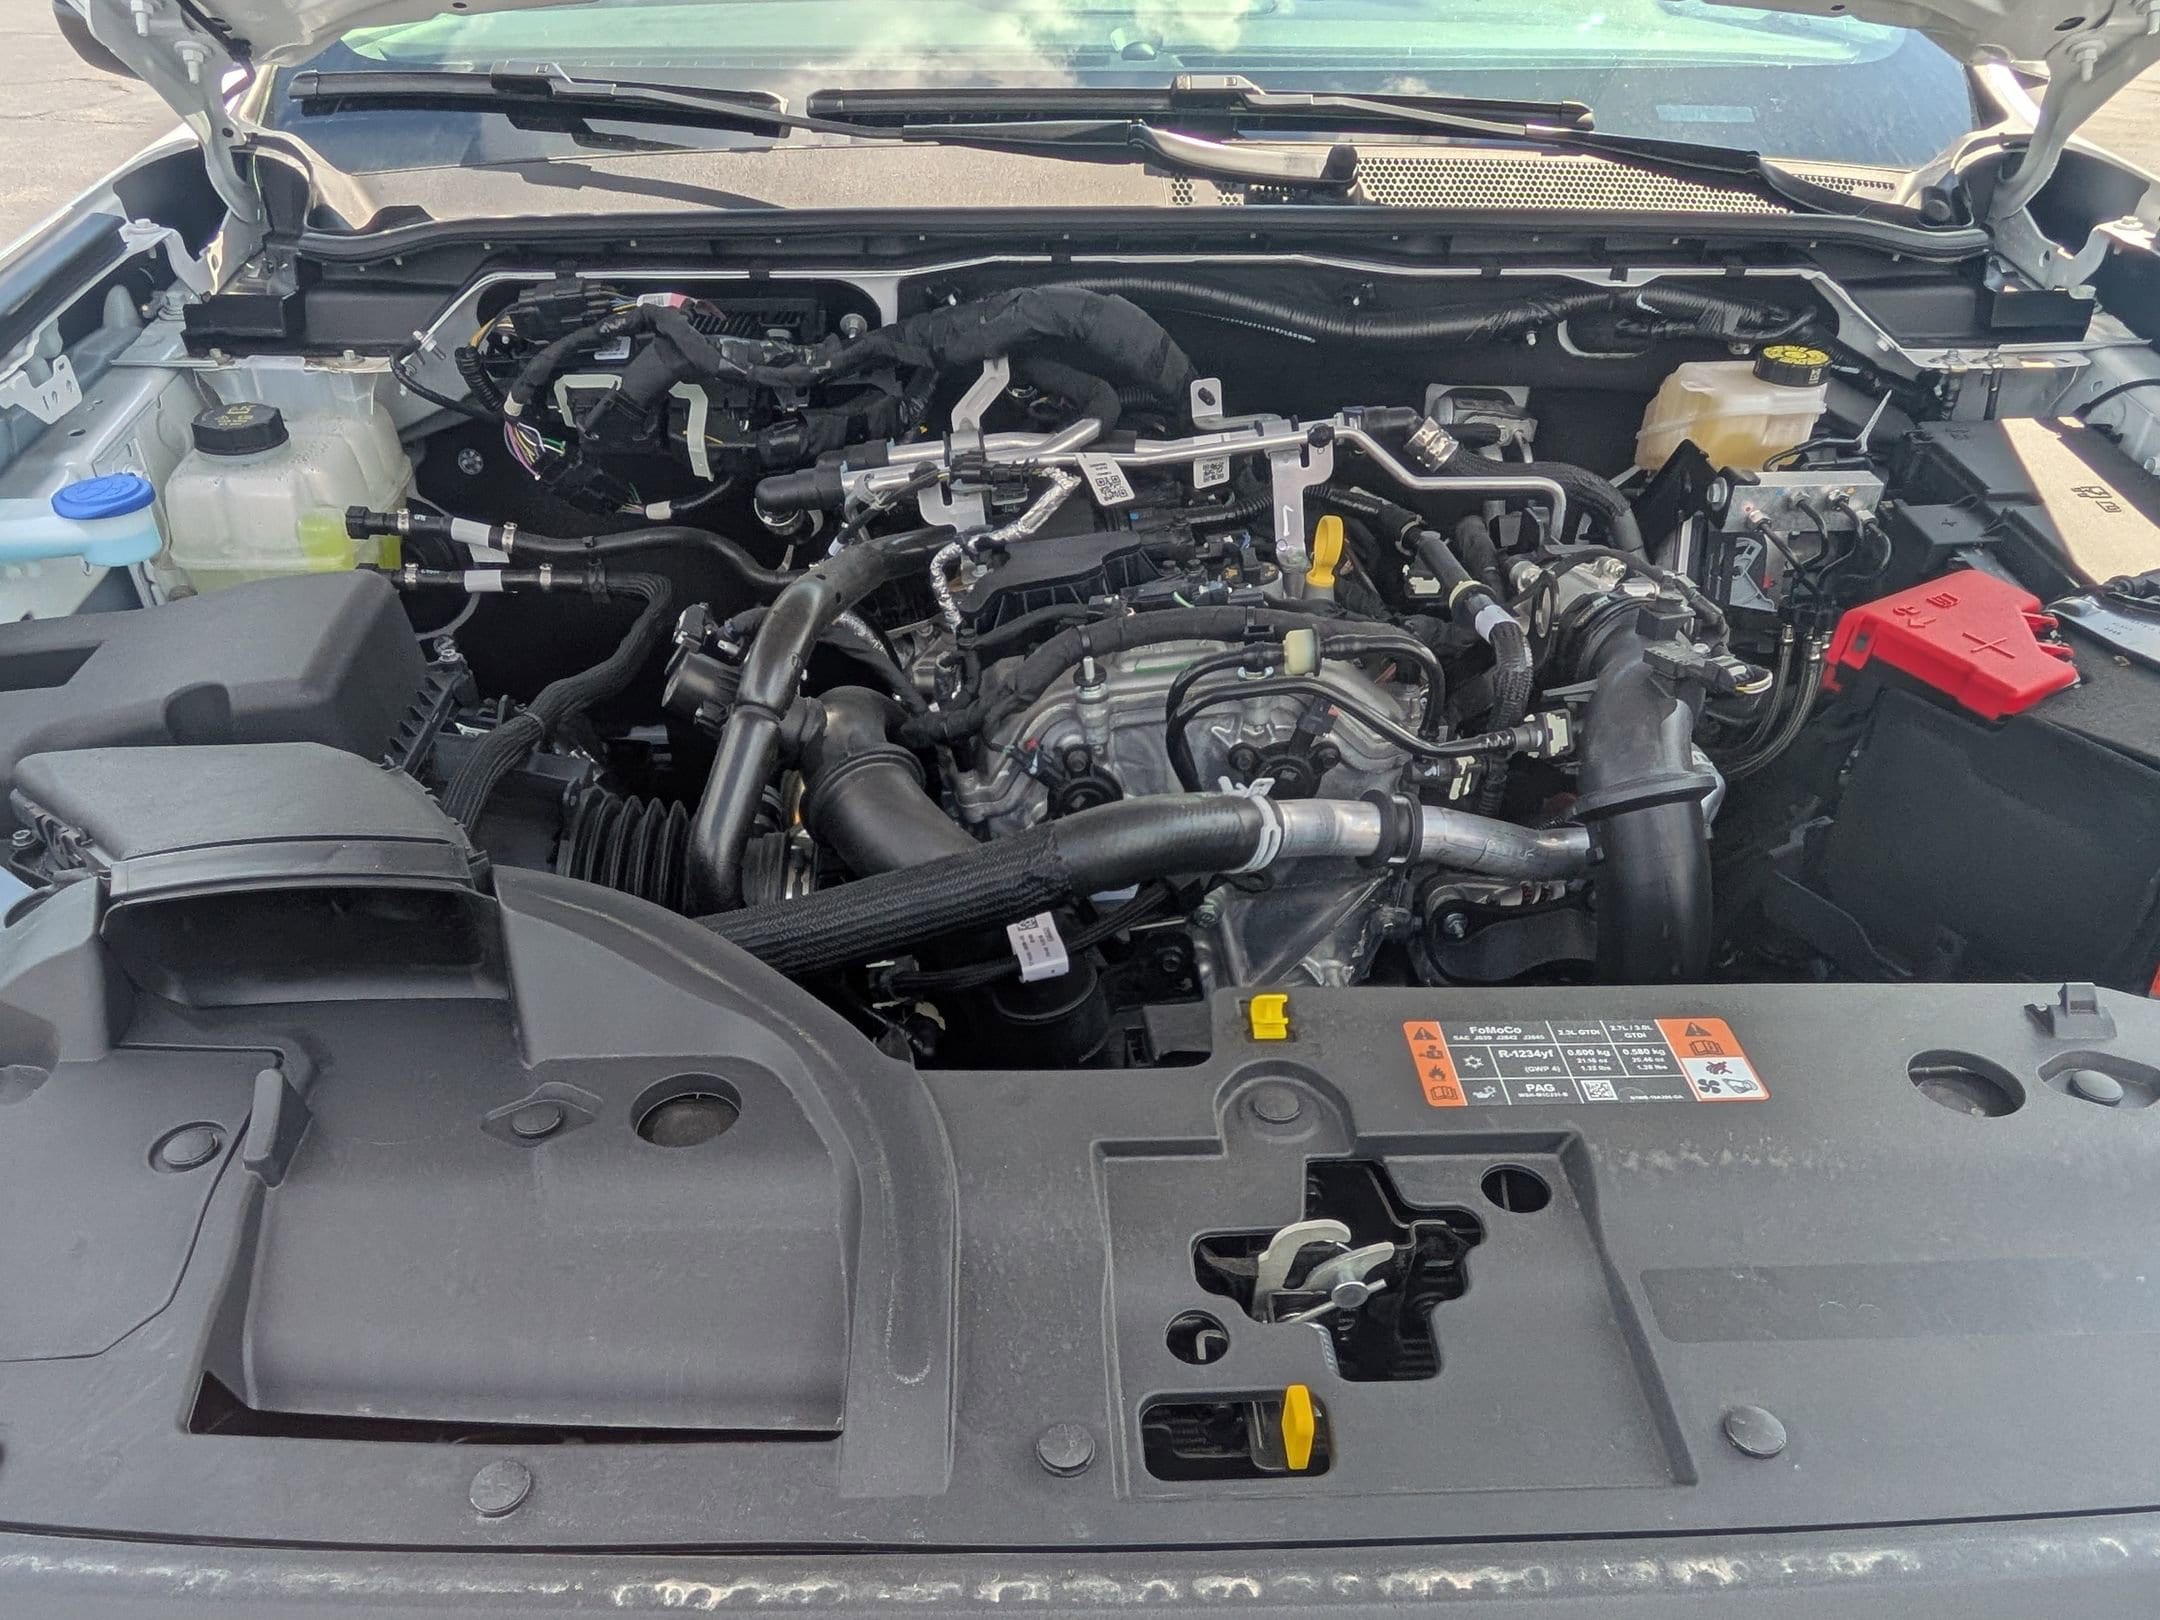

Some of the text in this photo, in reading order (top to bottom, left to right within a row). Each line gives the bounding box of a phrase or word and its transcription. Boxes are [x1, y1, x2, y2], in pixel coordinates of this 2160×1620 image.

[1469, 1026, 1522, 1034] FoMoCo
[1498, 1049, 1554, 1059] R-1234yf
[1596, 1049, 1611, 1057] kg
[1651, 1048, 1666, 1056] kg
[1525, 1083, 1555, 1092] PAG
